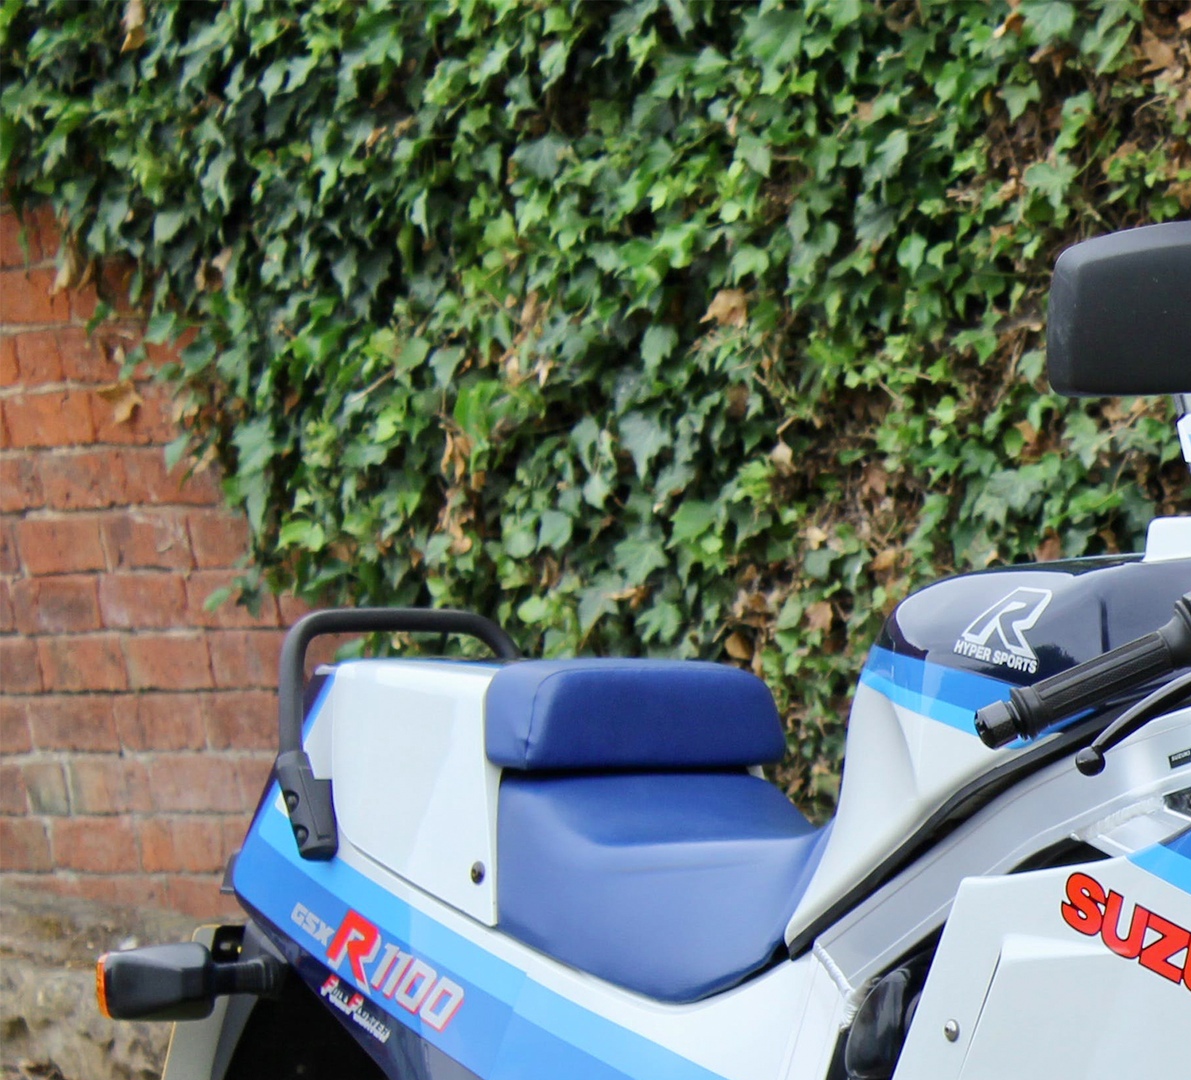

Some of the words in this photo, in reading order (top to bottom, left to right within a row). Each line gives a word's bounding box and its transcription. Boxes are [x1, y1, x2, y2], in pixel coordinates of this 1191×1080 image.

[961, 586, 1052, 659] R
[953, 639, 992, 663] HYPER
[992, 650, 1038, 675] SPORTS
